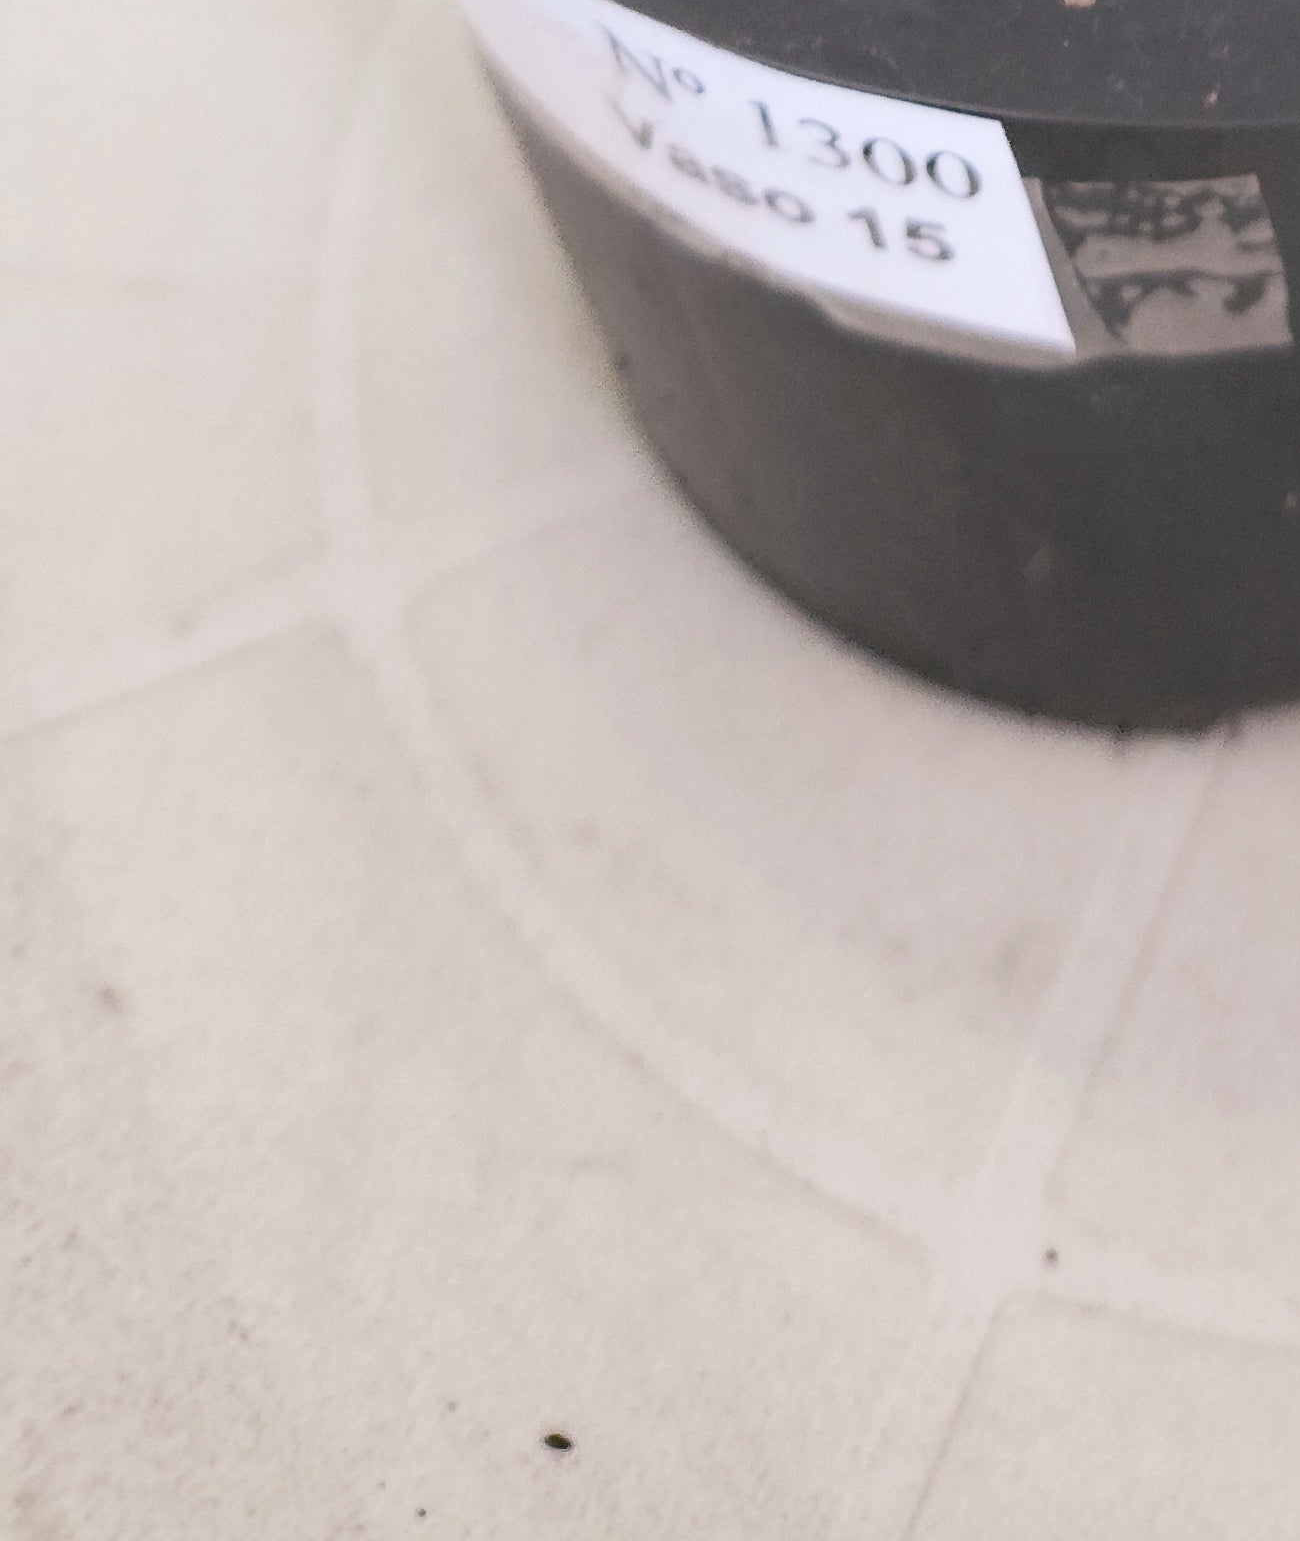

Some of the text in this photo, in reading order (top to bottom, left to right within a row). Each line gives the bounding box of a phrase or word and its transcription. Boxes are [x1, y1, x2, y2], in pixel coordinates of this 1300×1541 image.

[609, 95, 955, 263] Vaso 15
[747, 101, 981, 200] 1300
